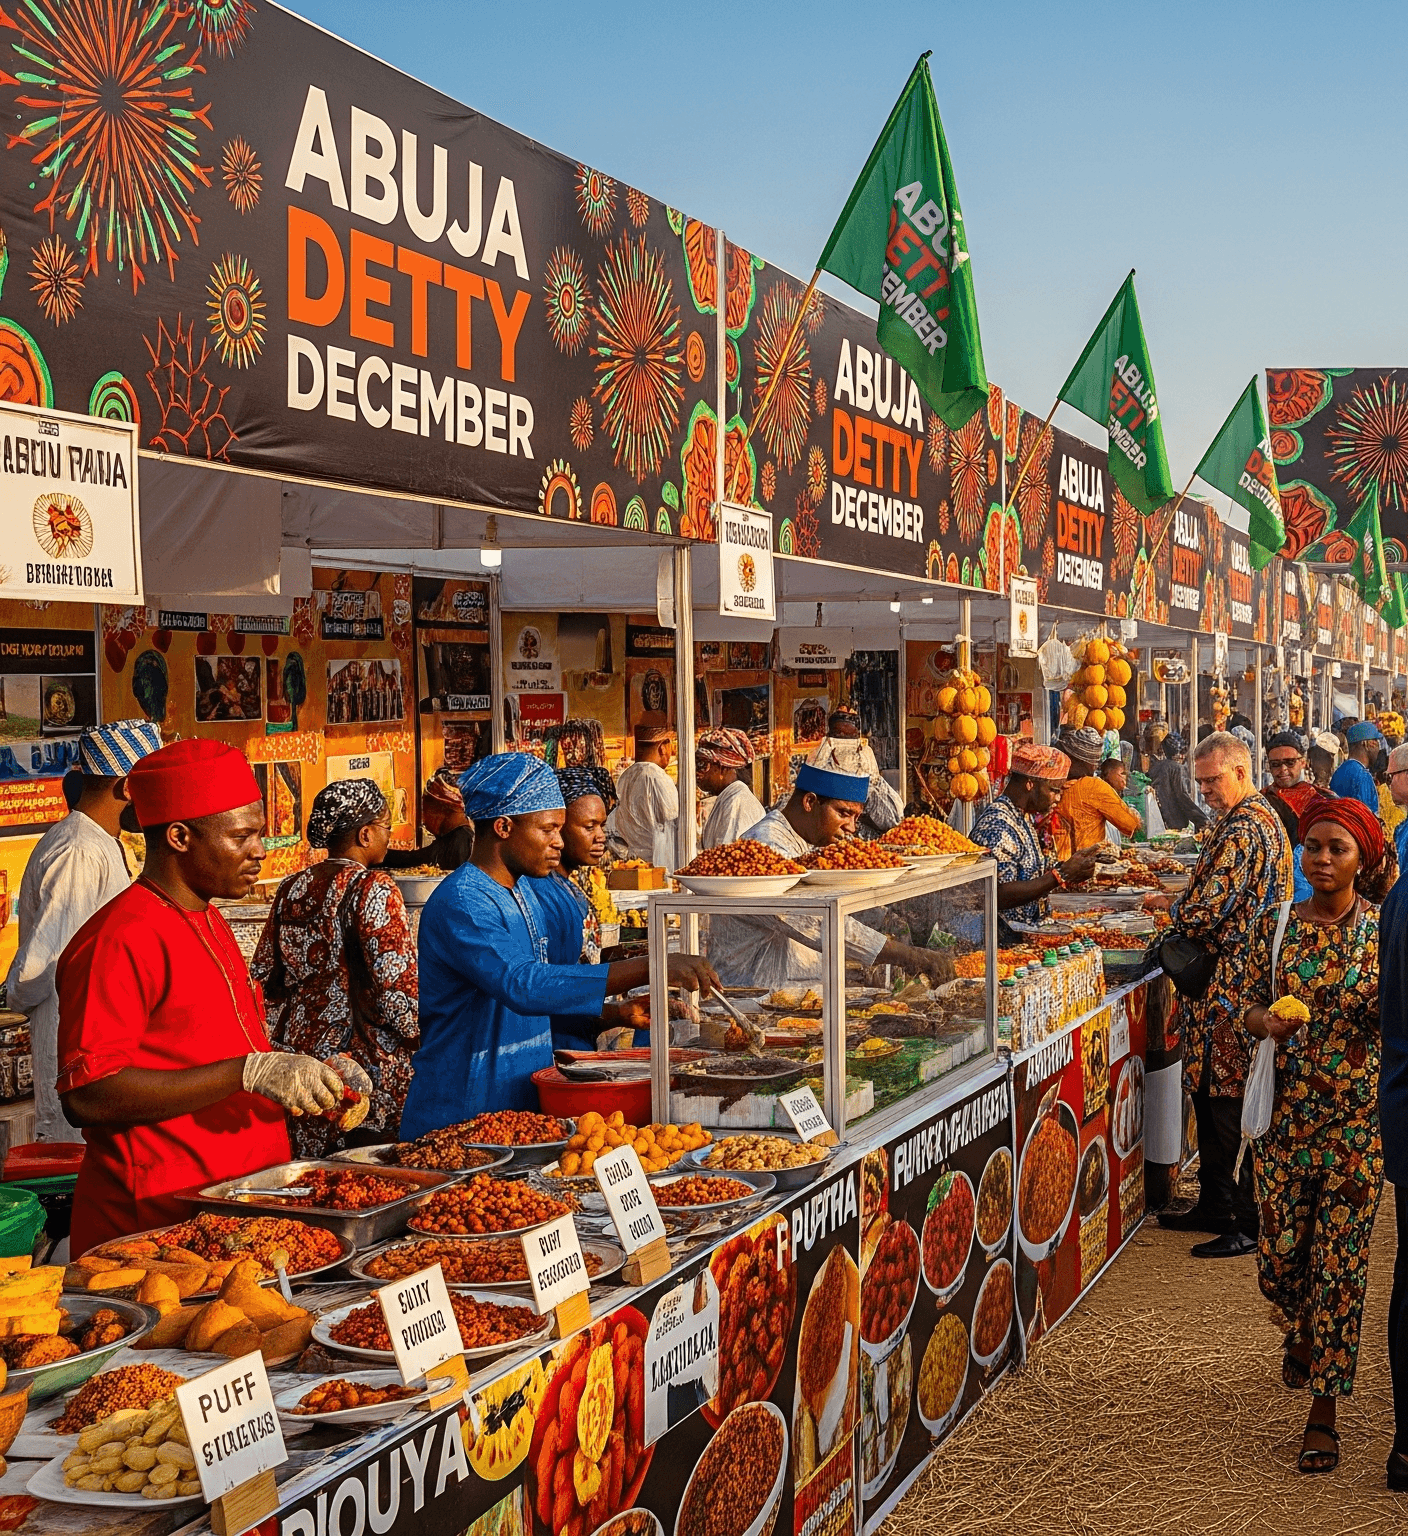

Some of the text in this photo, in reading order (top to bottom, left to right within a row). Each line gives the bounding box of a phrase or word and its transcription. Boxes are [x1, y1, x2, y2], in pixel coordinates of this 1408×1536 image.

[285, 84, 531, 280] ABUJA
[287, 204, 532, 383] DETTY
[286, 334, 535, 460] DECEMBER
[834, 337, 924, 433] ABUJA
[832, 407, 925, 499] DETTY
[1058, 453, 1105, 513] ABUJA
[831, 480, 924, 544] DECEMBER
[1057, 500, 1106, 558] DETTY
[197, 1371, 257, 1423] PUFF
